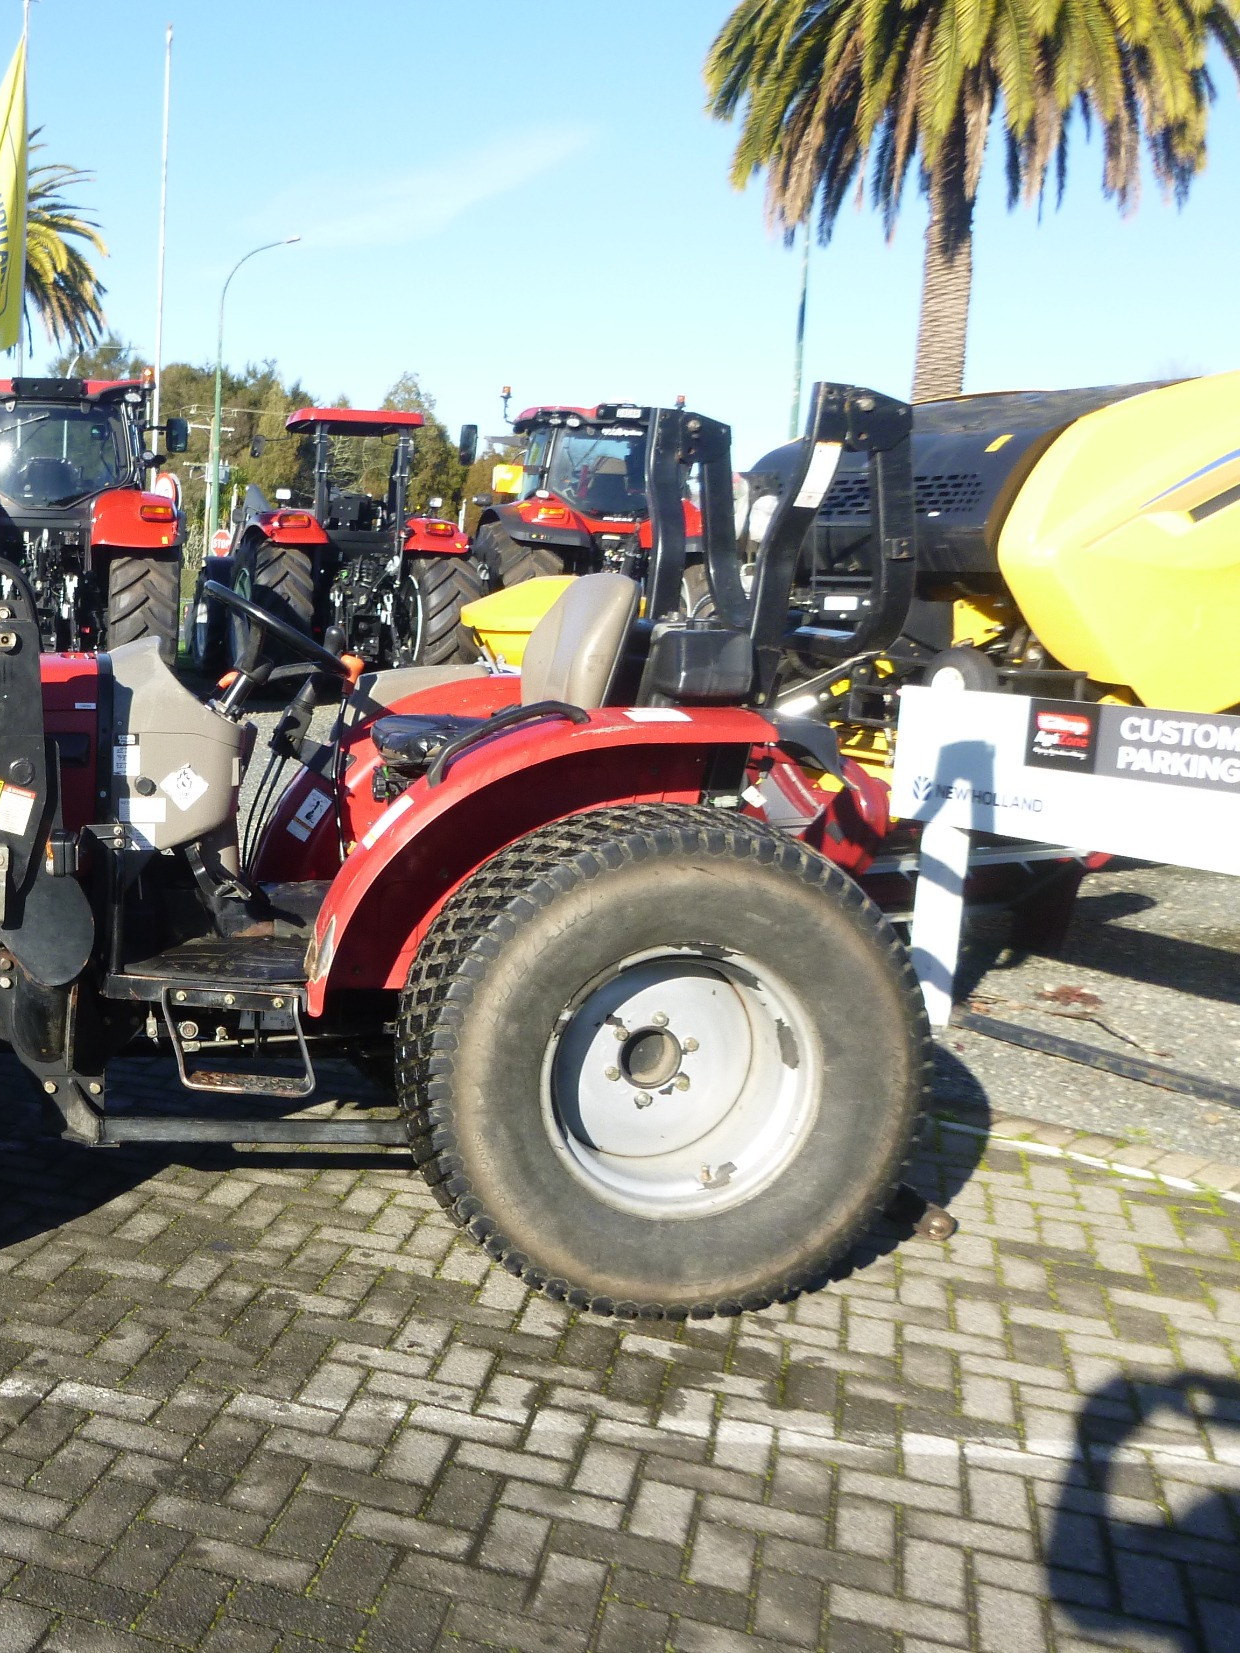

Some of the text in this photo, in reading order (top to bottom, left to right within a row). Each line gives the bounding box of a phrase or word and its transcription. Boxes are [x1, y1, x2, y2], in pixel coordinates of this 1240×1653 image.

[212, 539, 230, 549] STOP
[1116, 746, 1240, 783] PARKING
[935, 784, 1043, 813] NEW HOLLAND
